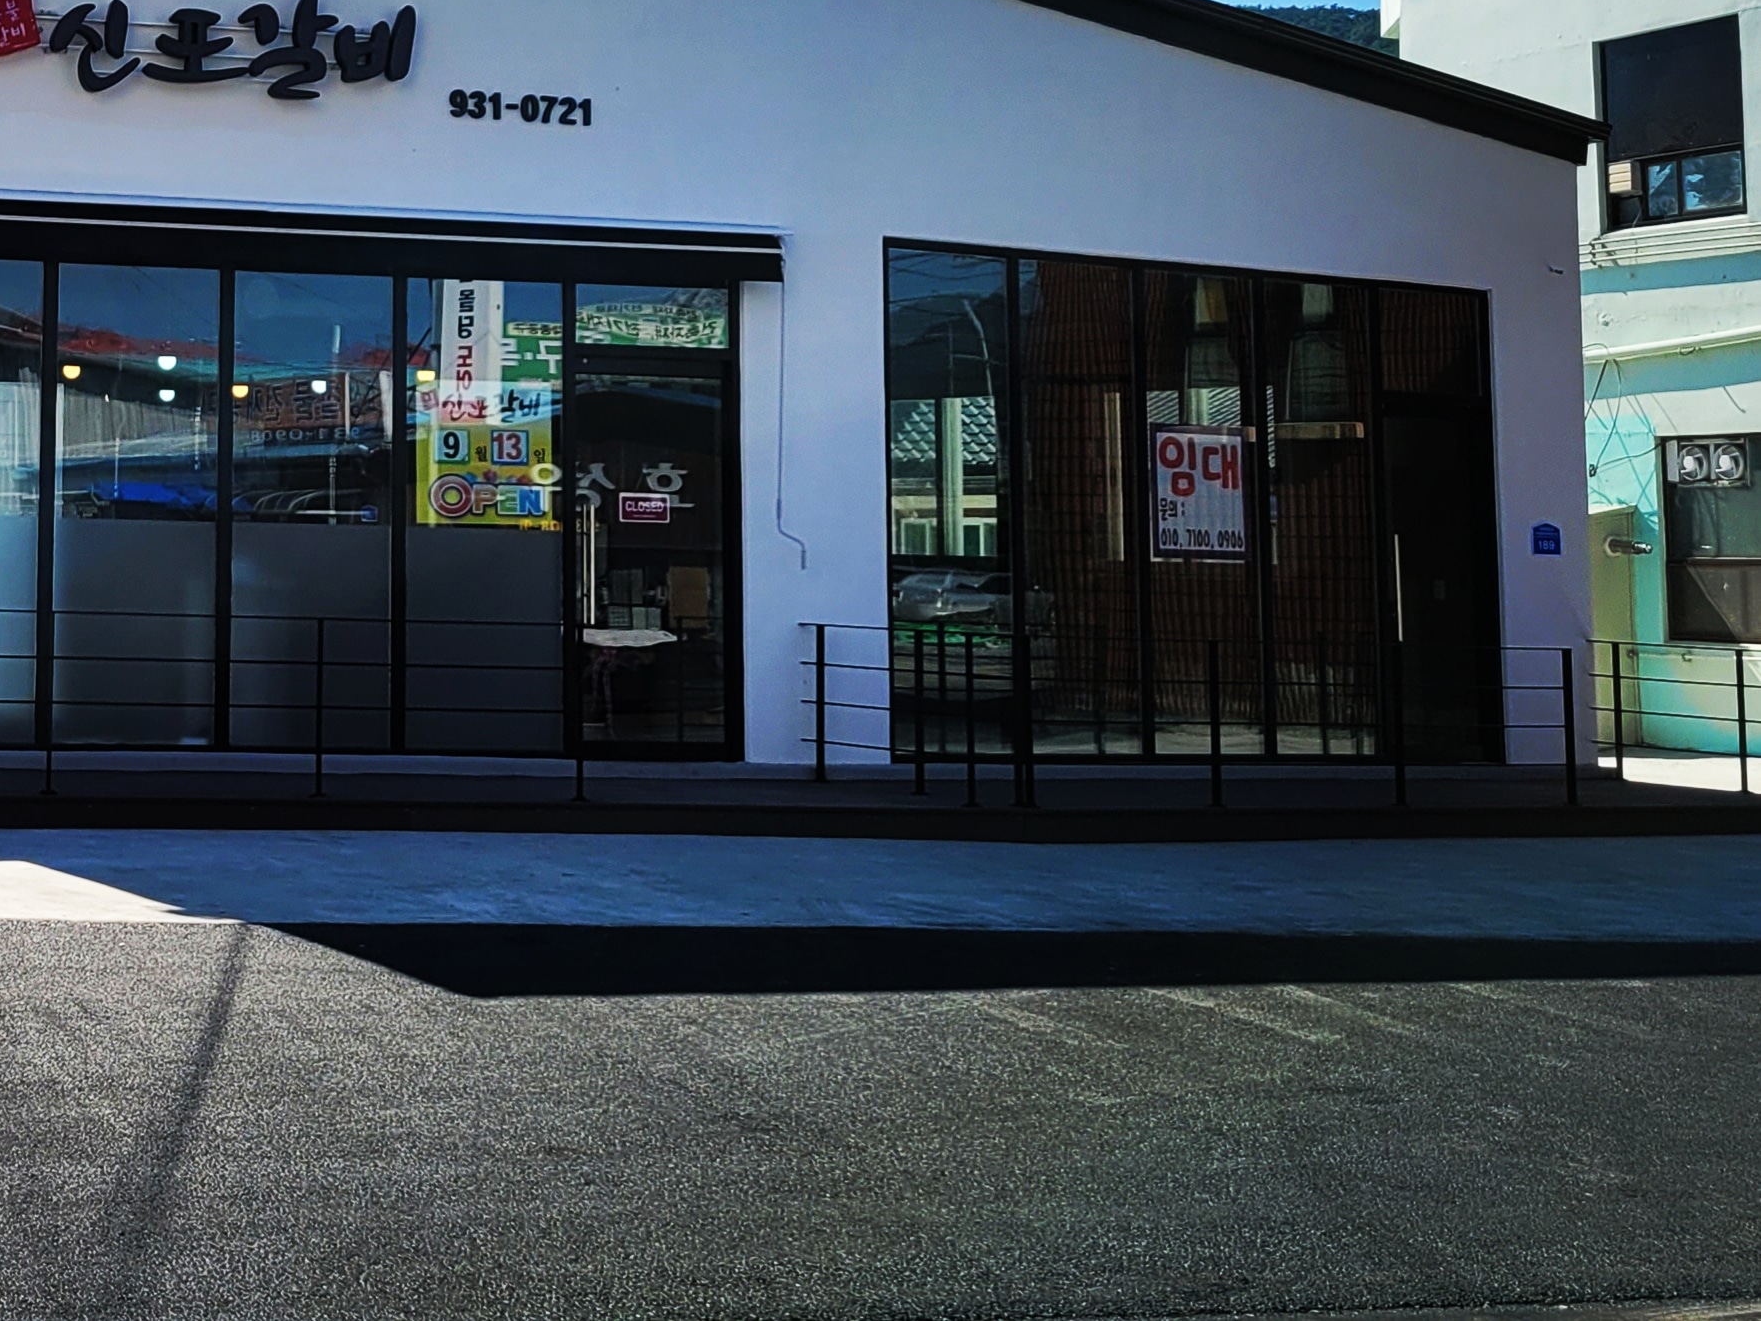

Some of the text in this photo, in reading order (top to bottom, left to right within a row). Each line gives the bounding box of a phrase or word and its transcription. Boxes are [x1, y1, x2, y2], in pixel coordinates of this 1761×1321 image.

[449, 89, 592, 126] 931-0721
[1159, 436, 1240, 497] 임대
[430, 474, 545, 517] OPEN
[625, 501, 665, 513] CLOSED
[1538, 540, 1555, 550] 189
